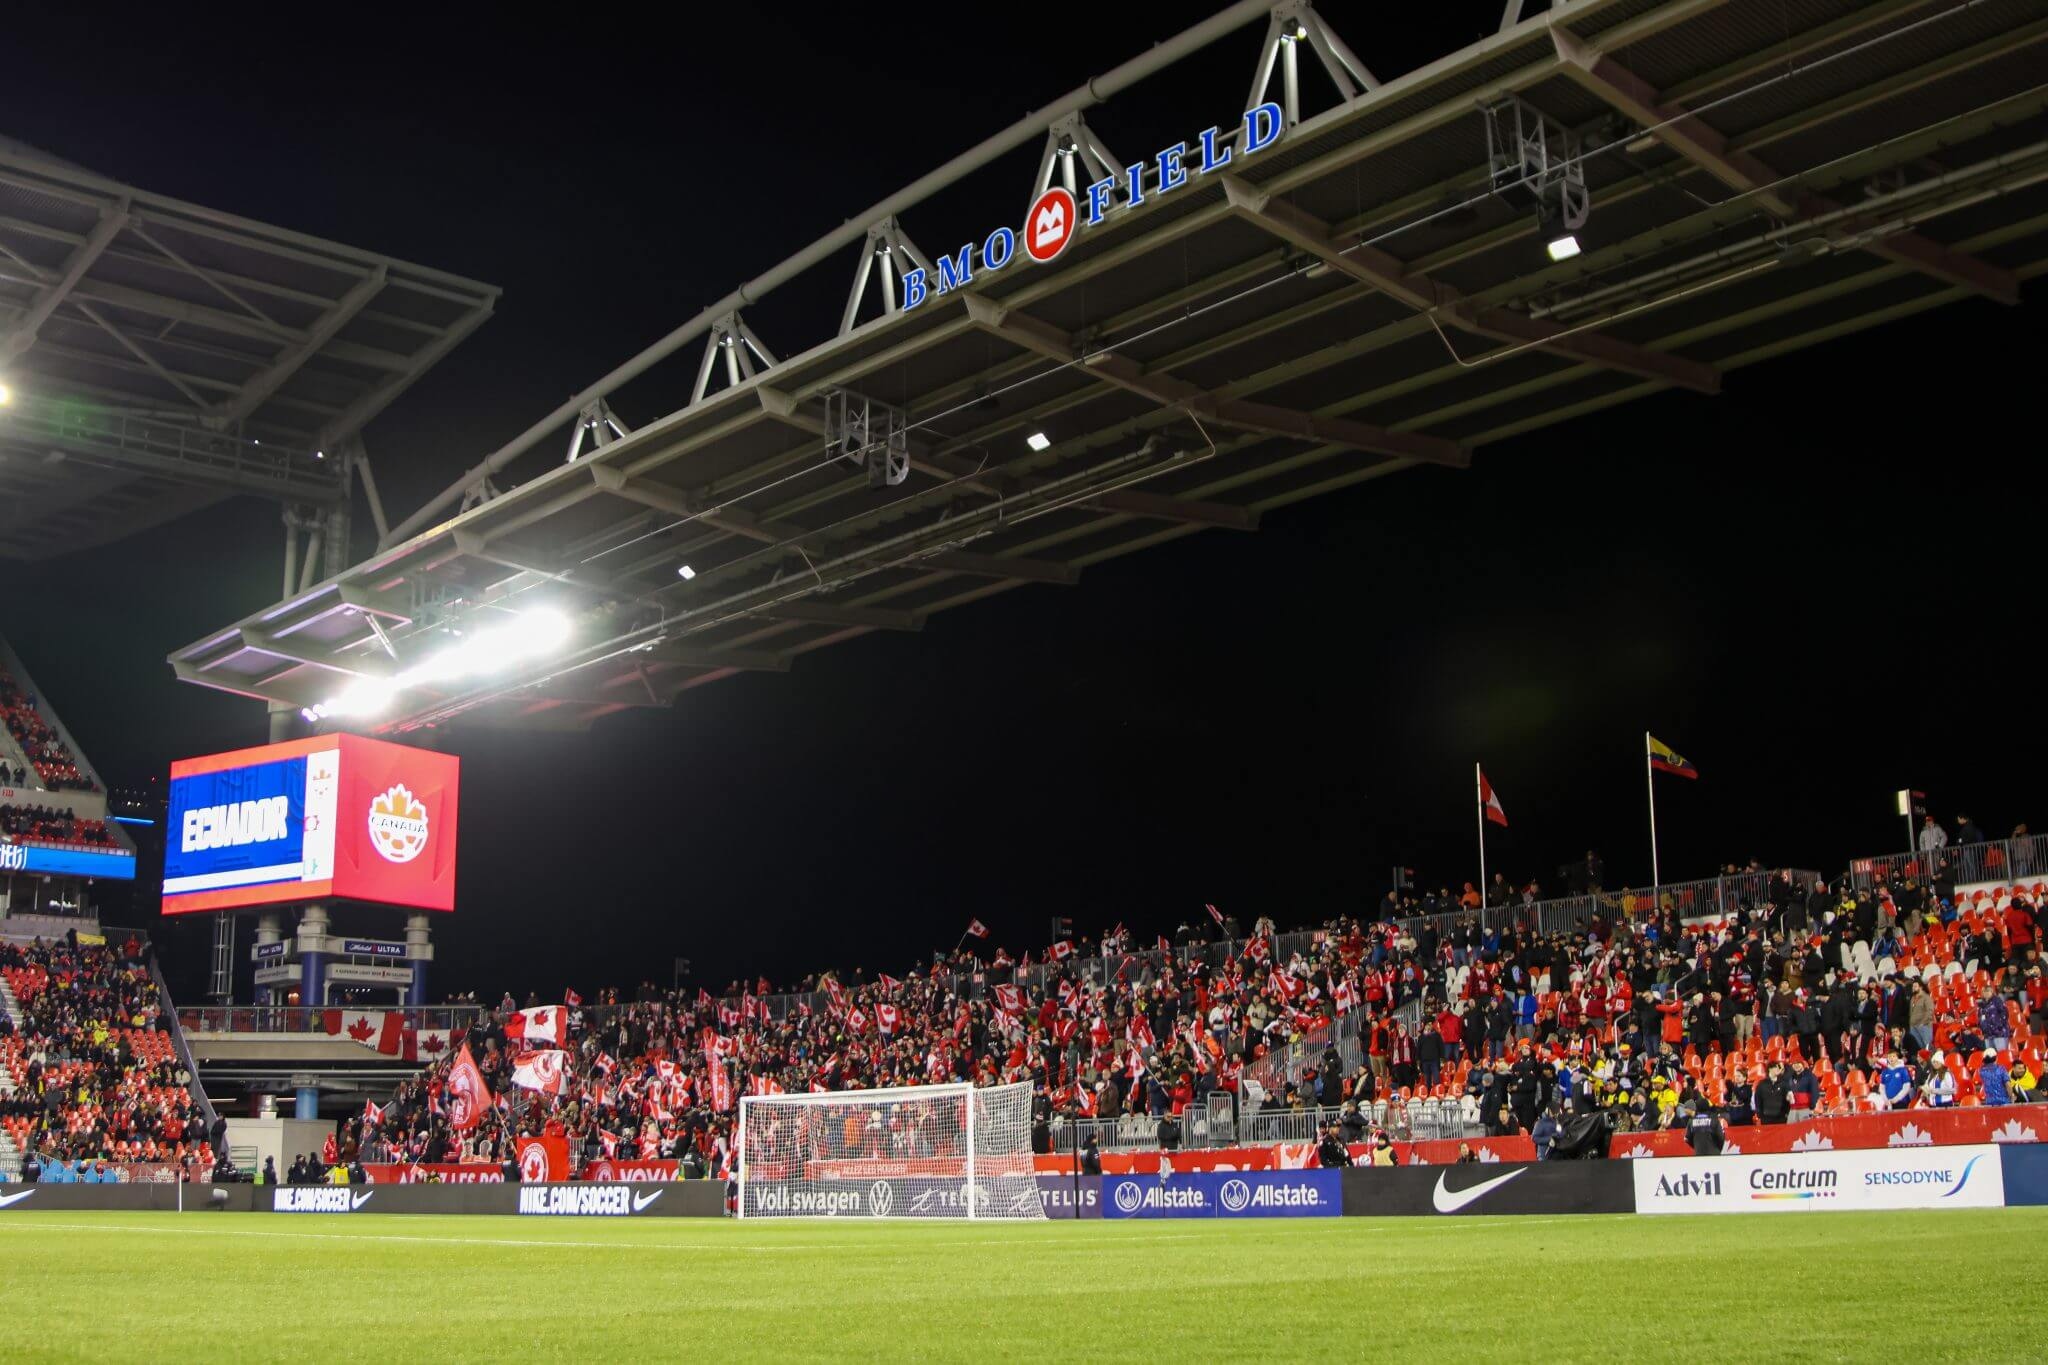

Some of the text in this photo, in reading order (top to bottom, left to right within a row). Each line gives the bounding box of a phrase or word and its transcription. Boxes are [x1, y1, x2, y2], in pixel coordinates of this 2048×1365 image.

[901, 101, 1286, 312] BMO FIELD
[181, 795, 289, 853] ECUADOR
[371, 816, 429, 835] CANADA
[1856, 861, 1870, 872] 116
[377, 945, 401, 954] ULTRA
[1654, 1172, 1721, 1198] Advil
[1749, 1168, 1837, 1189] Centrum
[1864, 1169, 1954, 1185] SENSODYNE
[519, 1186, 630, 1214] NIKE.COM/SOCCER
[755, 1186, 860, 1216] Volkswagen
[1143, 1187, 1204, 1208] Allstate
[1251, 1184, 1319, 1207] Allstate
